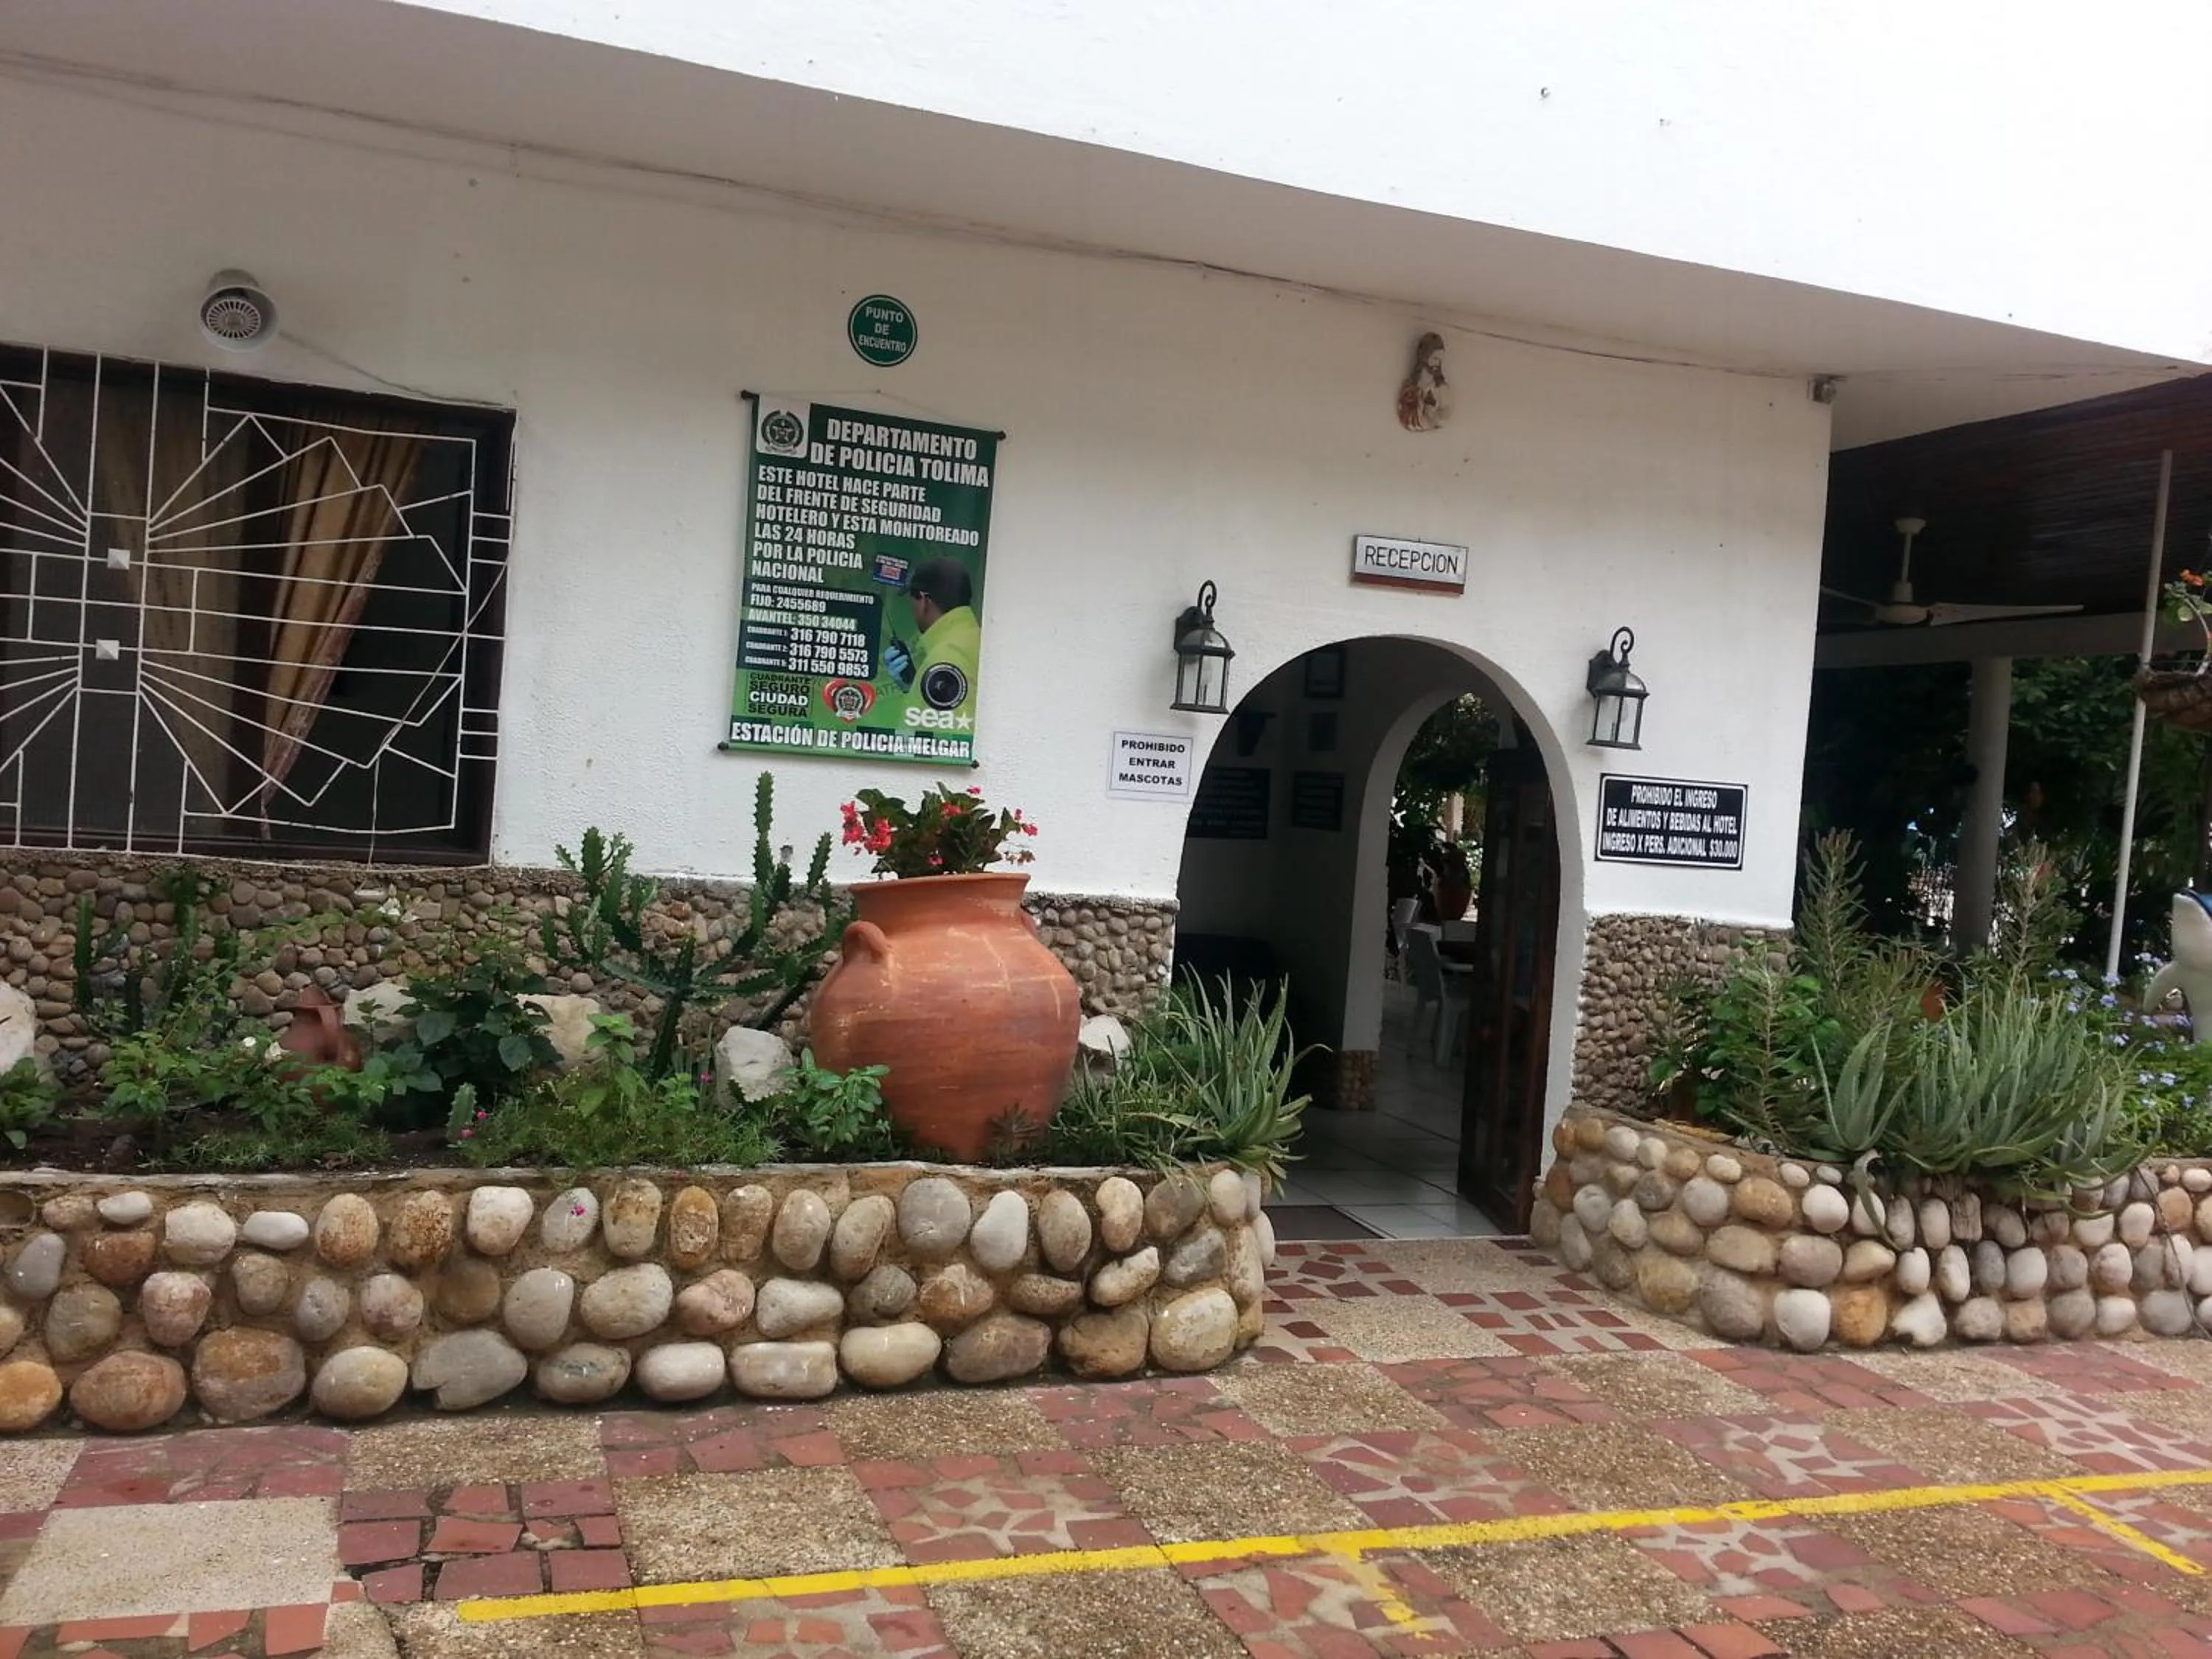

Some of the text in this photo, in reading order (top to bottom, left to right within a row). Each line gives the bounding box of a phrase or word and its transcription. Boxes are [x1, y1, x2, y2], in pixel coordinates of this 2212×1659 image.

[865, 306, 904, 323] PUNTO
[874, 322, 891, 335] DE
[827, 418, 978, 460] DEPARTAMENTO
[810, 442, 990, 487] DE POLICIA TOLIMA
[758, 465, 926, 502] ESTE HOTEL HACE PARTE
[757, 483, 942, 524] DEL FRENTE DE SEGURIDAD
[754, 521, 855, 549] LAS 24 HORAS
[755, 503, 979, 546] HOTELERO Y ESTA MONITOREADO
[753, 541, 782, 560] POR
[787, 545, 805, 562] LA
[807, 548, 863, 570] POLICIA
[1365, 545, 1459, 574] RECEPCION
[751, 560, 824, 584] NACIONAL
[751, 582, 772, 593] PARA
[750, 594, 774, 607] FIJO:
[798, 613, 819, 627] 350
[821, 616, 855, 631] 34044
[790, 627, 813, 642] 316
[815, 630, 838, 644] 790
[840, 632, 866, 647] 7118
[789, 642, 811, 657] 316
[814, 645, 836, 659] 790
[839, 647, 868, 663] 5573
[750, 672, 811, 684] CUADRANTE
[788, 657, 809, 672] 311
[811, 660, 835, 675] 550
[838, 663, 869, 678] 9853
[749, 680, 810, 695] SEGURO
[750, 691, 808, 706] CIUDAD
[748, 703, 808, 717] SEGURA
[904, 706, 954, 729] sea
[731, 722, 970, 758] ESTACIÓN DE POLICIA MELGAR
[1121, 740, 1185, 753] PROHIBIDO
[1129, 757, 1175, 769] ENTRAR
[1119, 772, 1182, 786] MASCOTAS
[1631, 785, 1718, 809] PROHIBIDO EL INGRESO
[1607, 807, 1737, 835] DE ALIMENTOS Y BEBIDAS AL HOTEL
[1602, 832, 1737, 858] INGRESO X PERS. ADICIONAL $30.000
